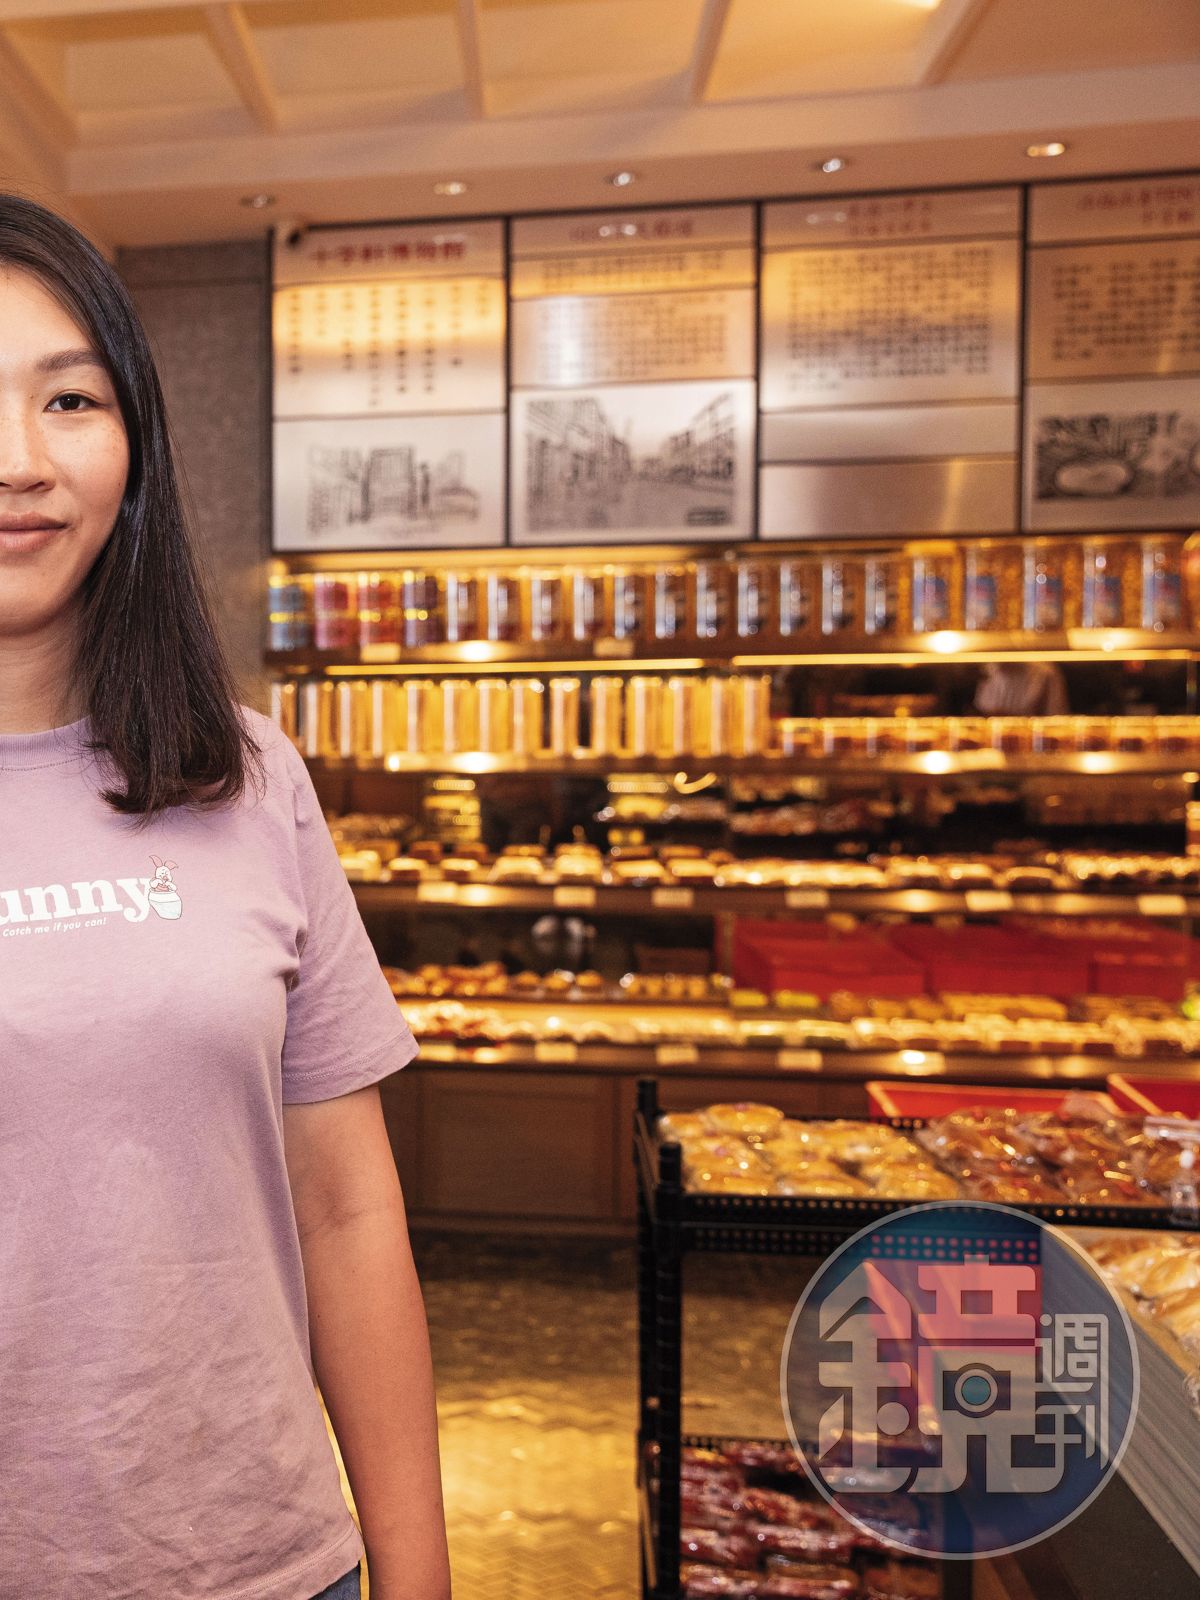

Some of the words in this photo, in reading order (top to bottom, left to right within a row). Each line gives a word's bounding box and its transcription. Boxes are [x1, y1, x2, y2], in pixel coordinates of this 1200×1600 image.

[53, 922, 61, 932] if
[63, 921, 81, 932] you
[85, 917, 107, 928] can!
